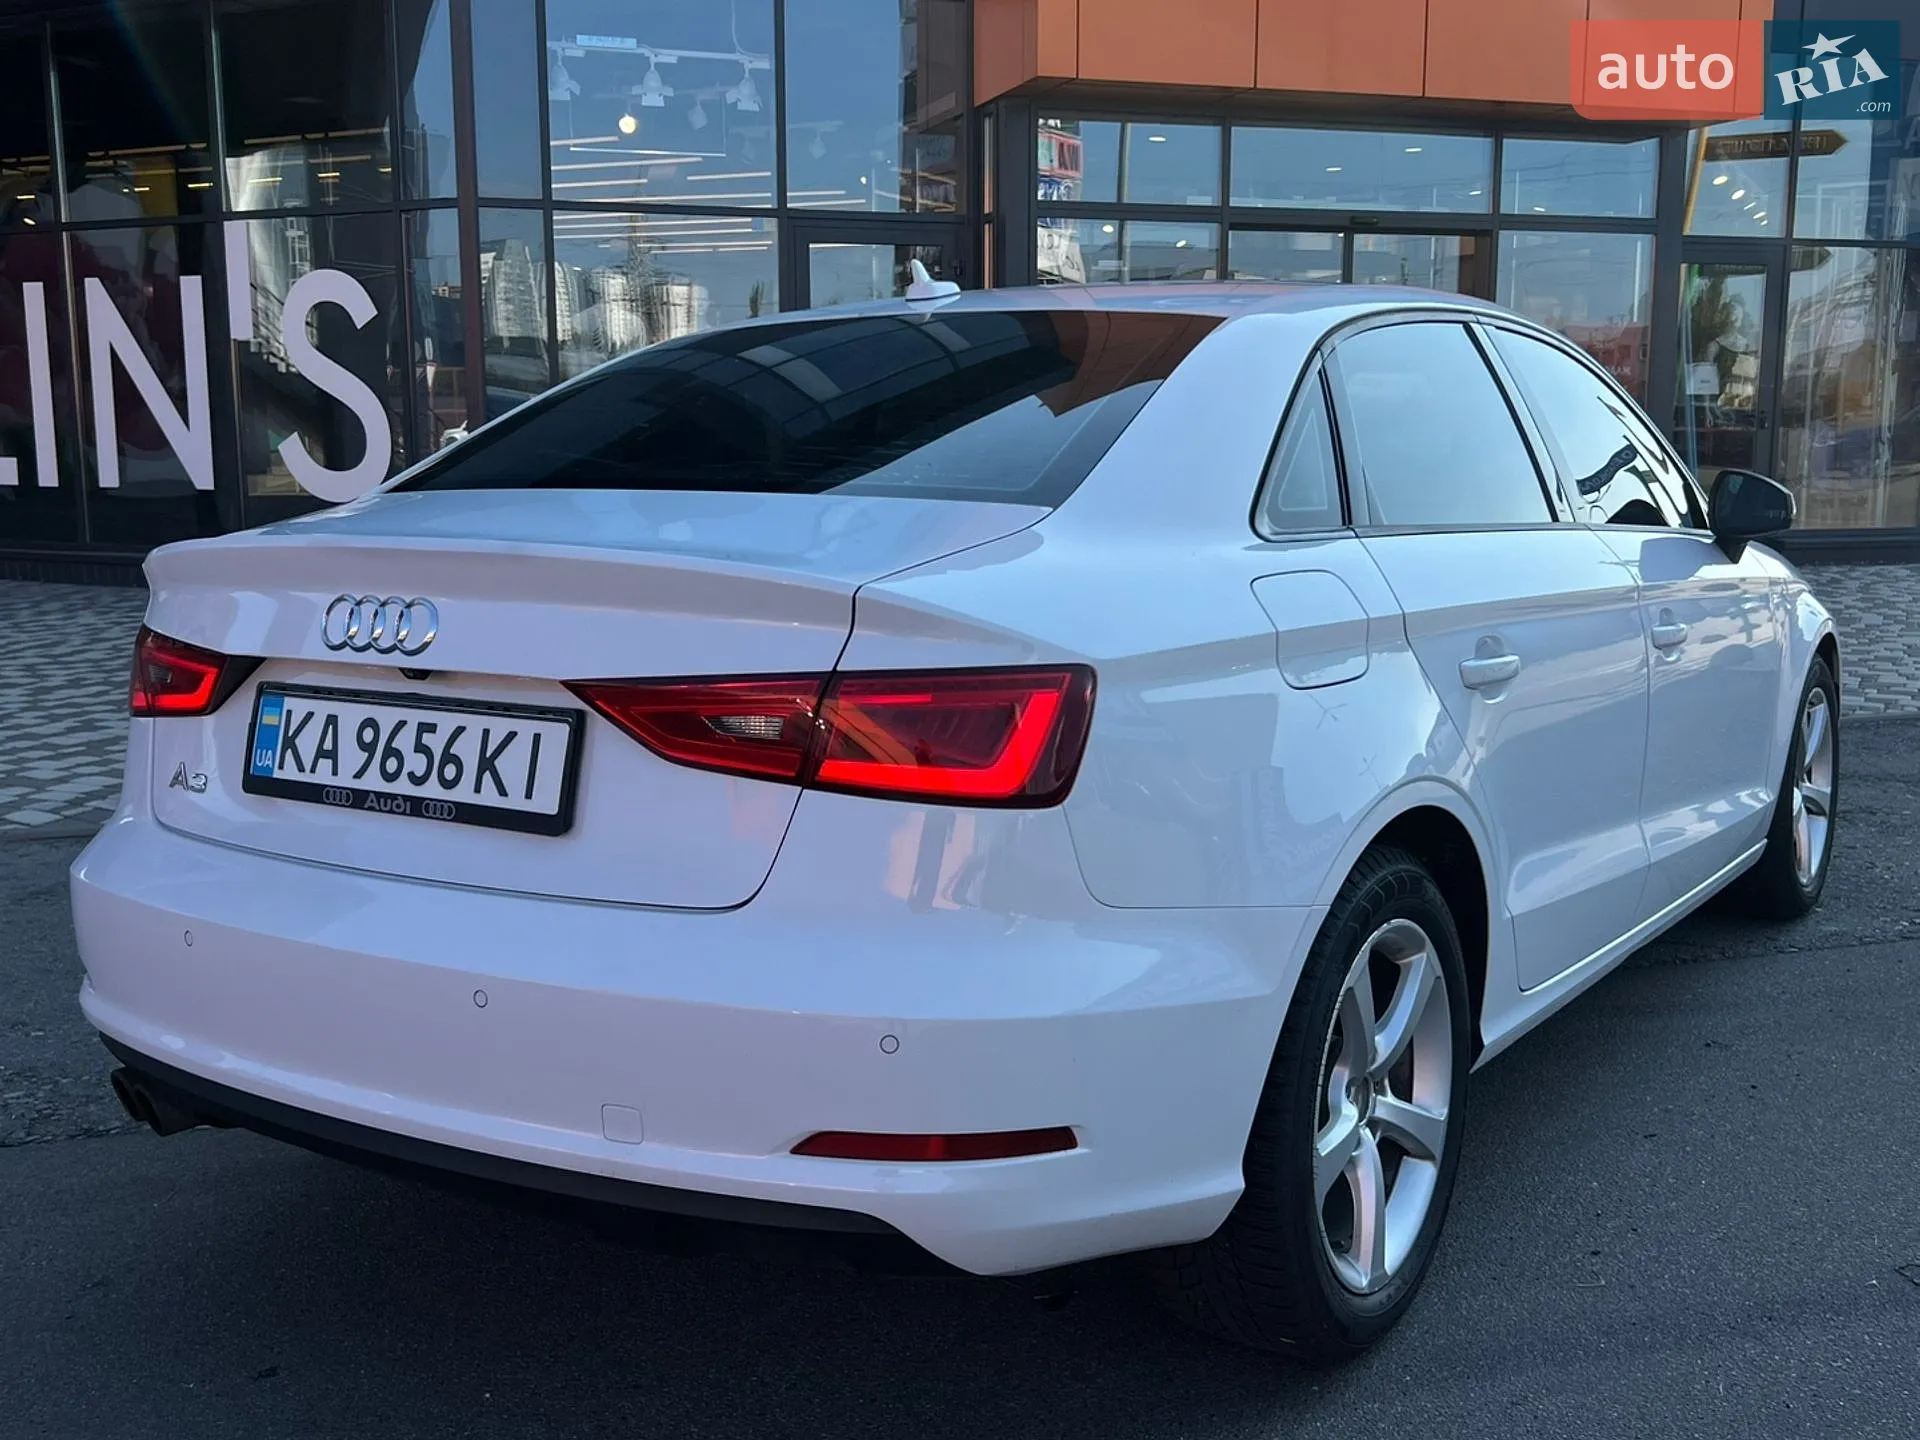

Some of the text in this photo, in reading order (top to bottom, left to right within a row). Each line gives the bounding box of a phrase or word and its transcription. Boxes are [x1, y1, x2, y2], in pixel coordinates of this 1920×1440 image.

[0, 221, 391, 503] IN'S
[256, 748, 274, 770] UA
[168, 761, 209, 793] A3
[364, 794, 412, 815] Audi
